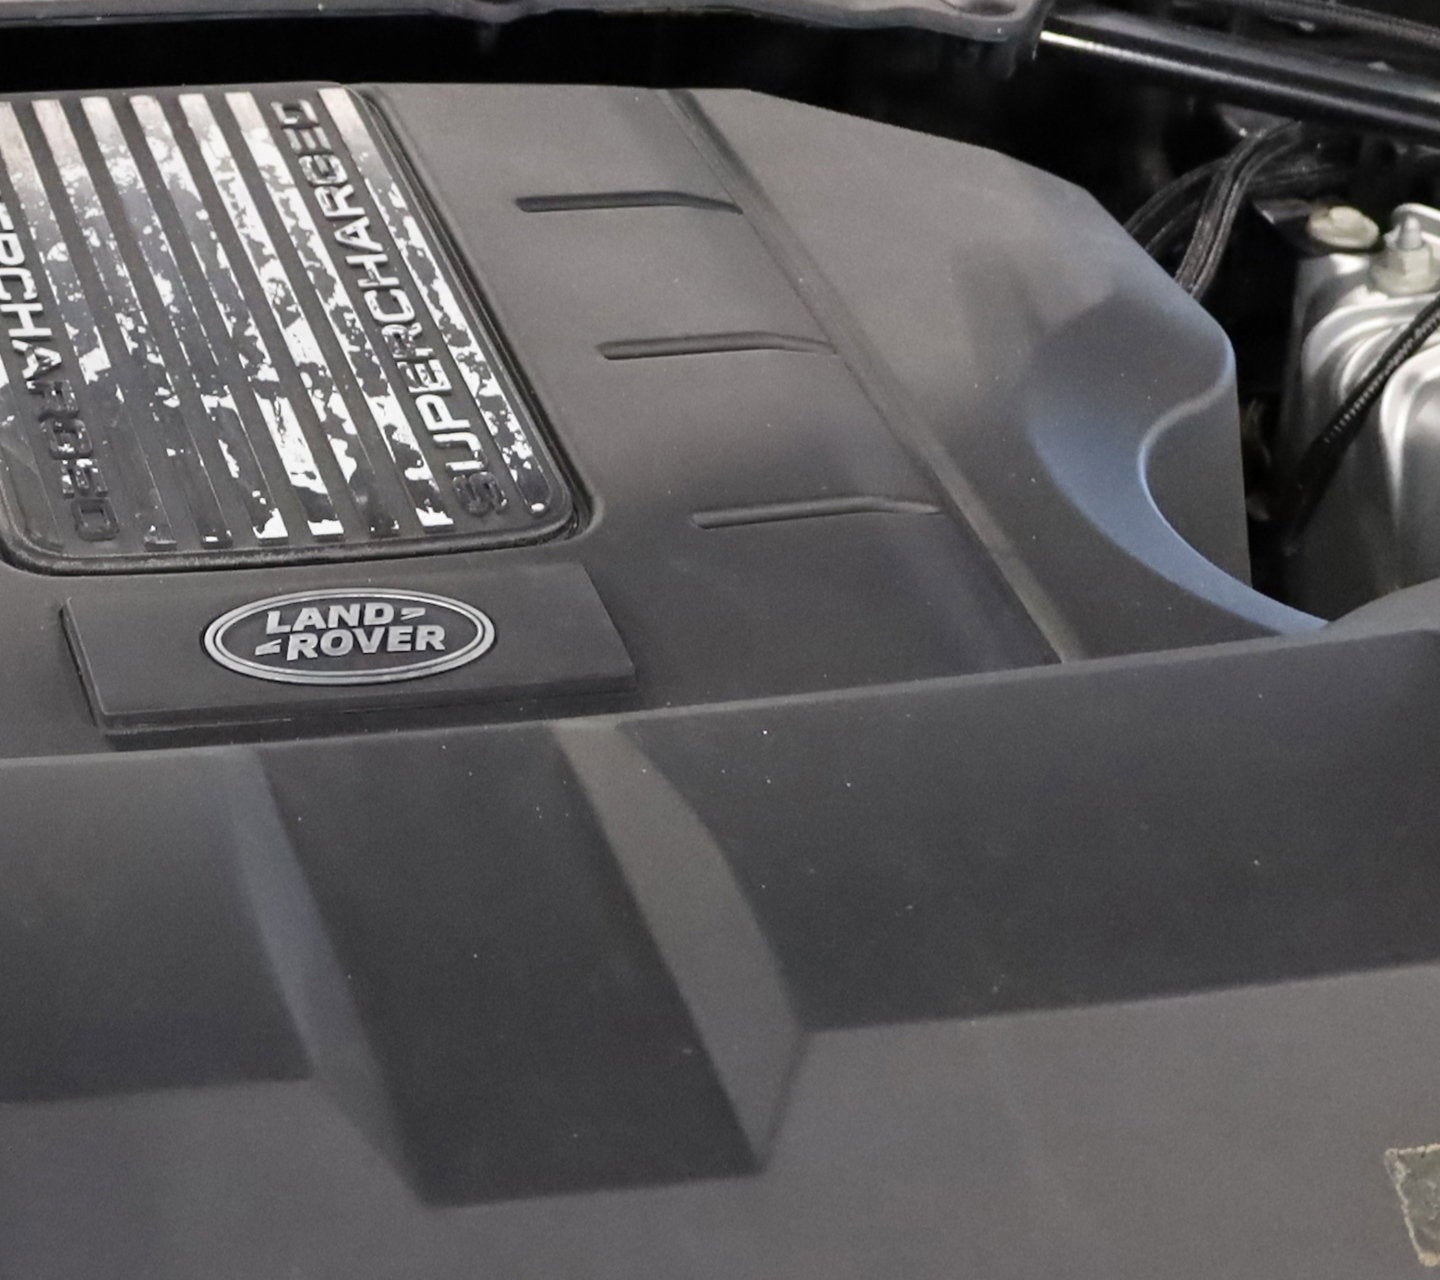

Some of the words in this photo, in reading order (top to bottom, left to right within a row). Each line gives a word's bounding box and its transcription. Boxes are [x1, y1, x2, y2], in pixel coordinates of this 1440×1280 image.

[271, 98, 509, 516] SUPERCHARGED
[266, 602, 395, 635] LAND
[286, 624, 446, 661] ROVER
